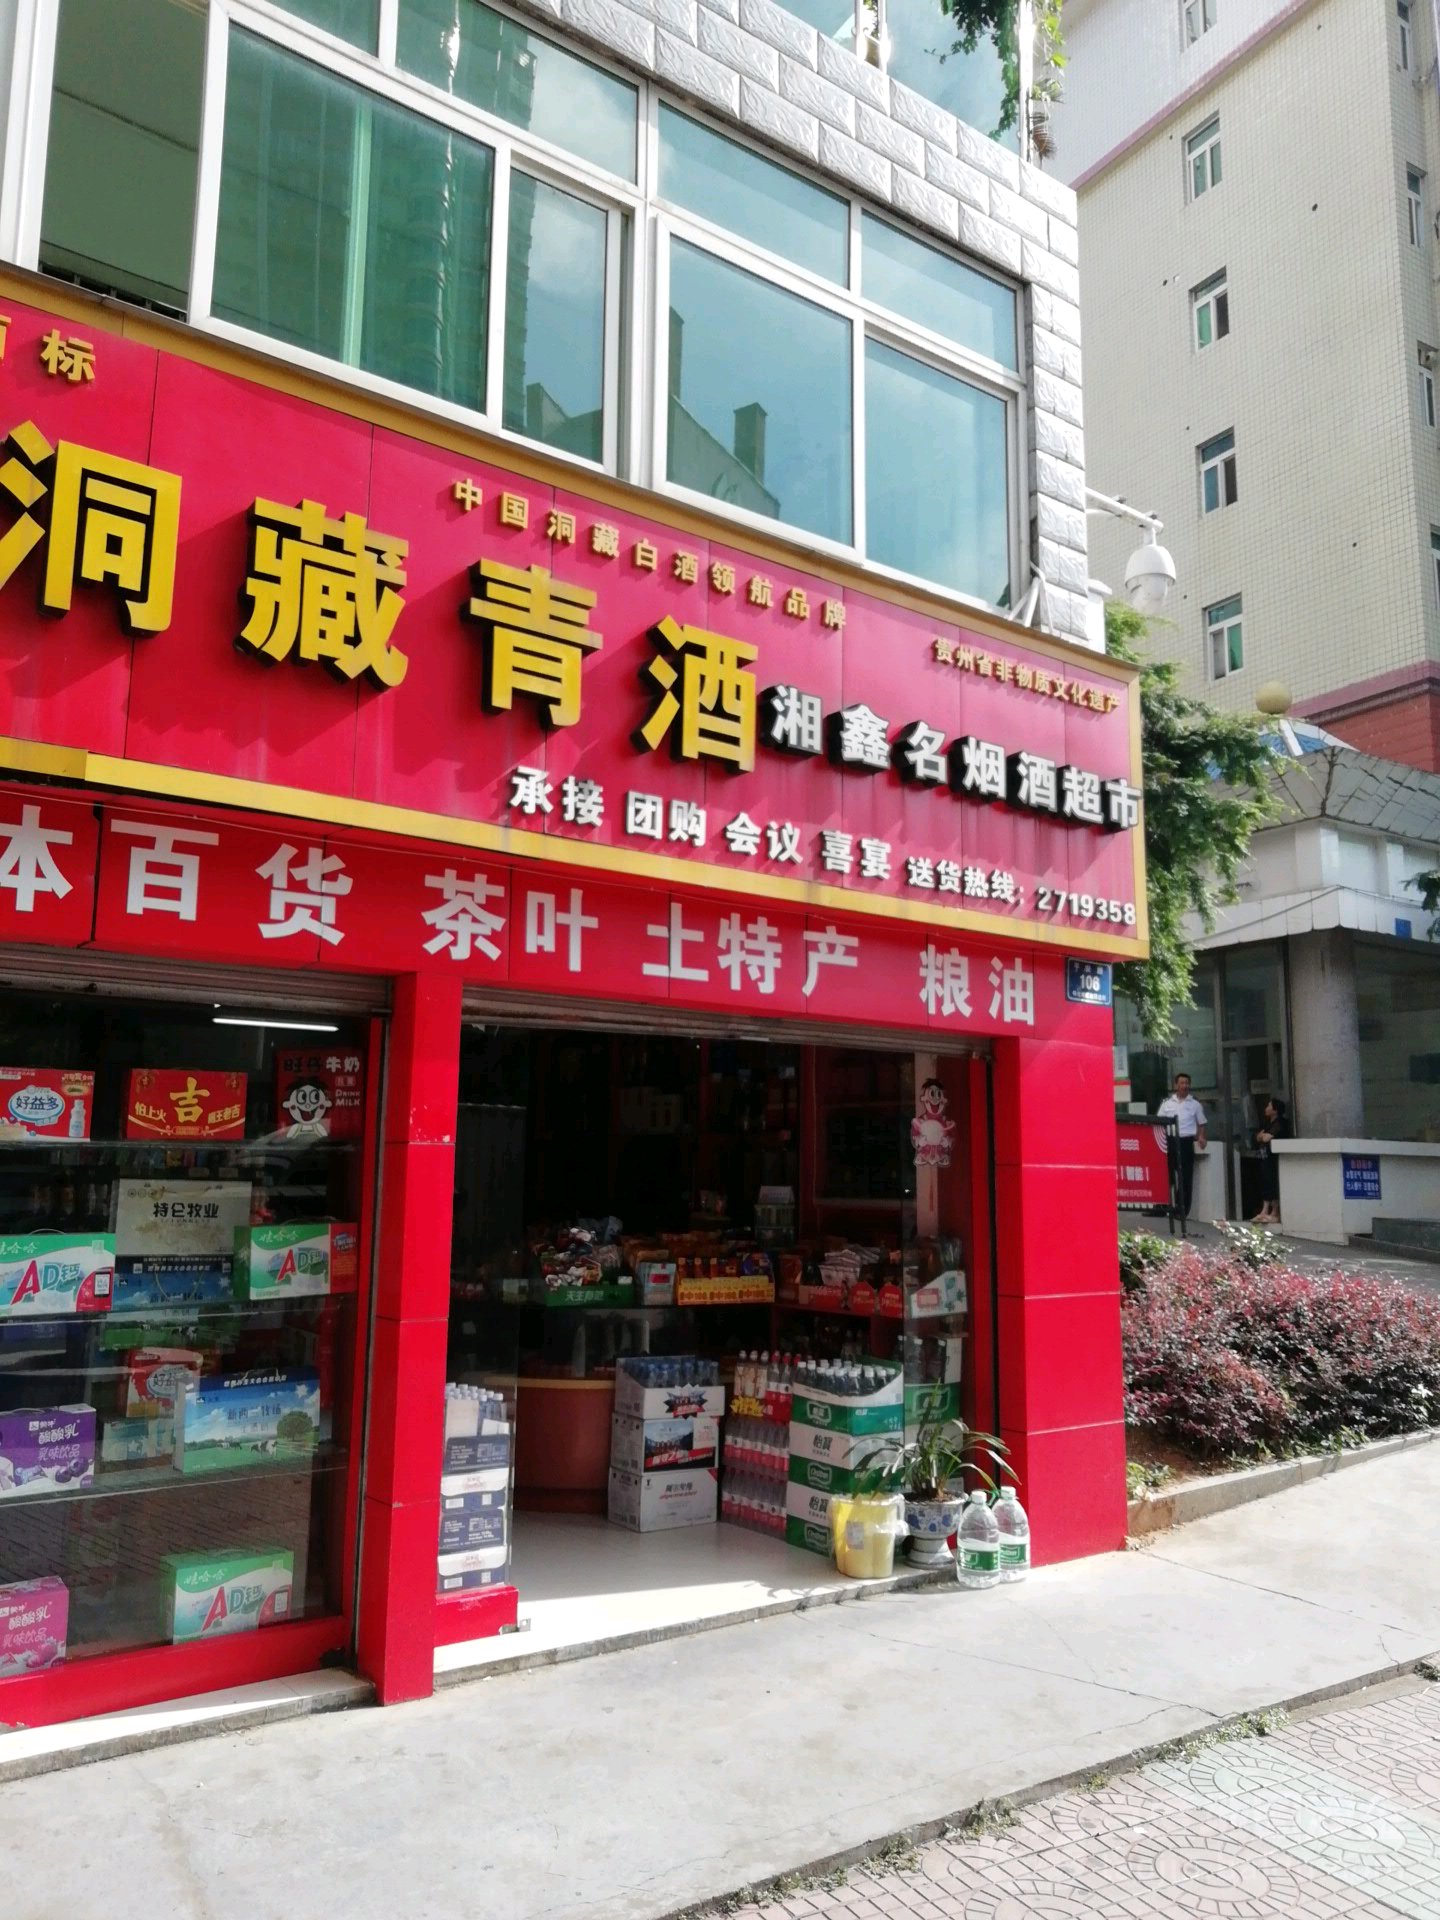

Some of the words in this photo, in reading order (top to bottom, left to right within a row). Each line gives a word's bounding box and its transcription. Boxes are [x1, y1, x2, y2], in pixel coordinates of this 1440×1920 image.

[0, 316, 96, 384] 标
[0, 420, 758, 773] 洞藏青酒
[453, 478, 847, 631] 中国洞藏白酒领航品牌
[932, 637, 1121, 714] 贵州省非物质文化遗产
[766, 684, 1143, 832] 湘鑫名烟酒超市
[510, 767, 606, 829] 承接
[625, 790, 708, 847] 团购
[725, 812, 804, 865] 会议
[821, 829, 893, 881] 喜宴
[422, 867, 599, 973] 茶叶
[642, 902, 860, 998] 土特产
[919, 943, 1036, 1027] 粮油
[1080, 974, 1101, 992] 106
[15, 1095, 59, 1111] 好益多
[169, 1076, 211, 1123] 吉
